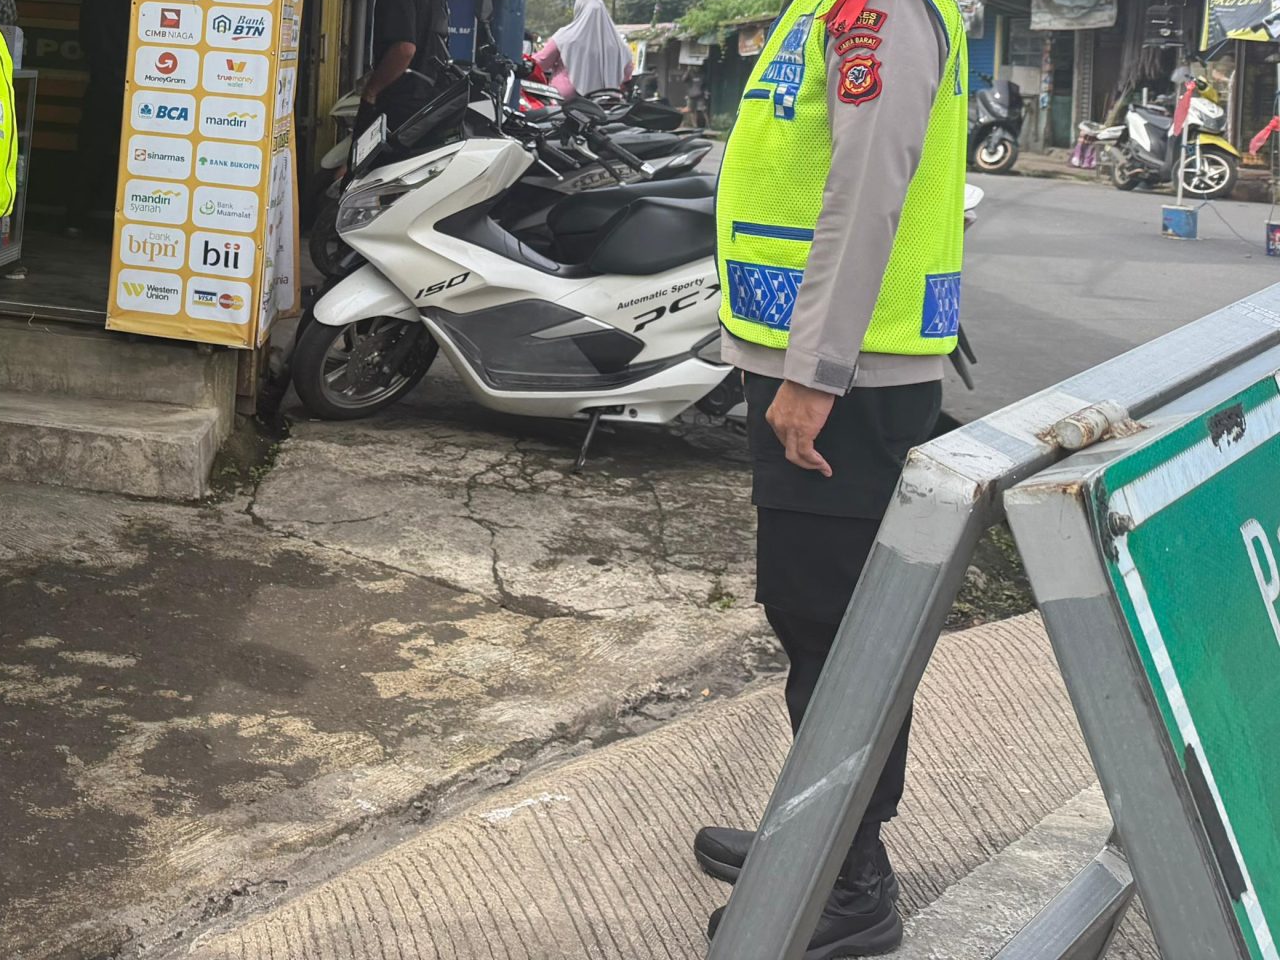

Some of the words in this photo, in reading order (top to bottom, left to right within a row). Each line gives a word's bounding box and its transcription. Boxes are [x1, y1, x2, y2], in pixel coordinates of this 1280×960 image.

[238, 15, 265, 26] Bank
[145, 29, 167, 38] CIMB
[167, 30, 193, 40] NIAGA
[233, 25, 265, 37] BTN
[840, 40, 855, 51] JAWA
[855, 37, 877, 47] BARAT
[145, 74, 186, 85] MoneyGram
[217, 74, 253, 83] truemoney
[156, 105, 189, 121] BCA
[206, 116, 247, 128] mandiri
[147, 152, 185, 162] sinarmas
[209, 159, 228, 167] BANK
[230, 161, 260, 170] BUKOPIN
[131, 193, 171, 205] mandiri
[217, 209, 251, 219] Muamalat
[149, 232, 171, 241] bank
[128, 234, 177, 262] btpn
[202, 240, 241, 269] bii
[147, 284, 179, 295] Western
[414, 271, 471, 300] 150
[146, 291, 170, 301] Union
[616, 286, 669, 311] Automatic
[670, 276, 705, 299] Sporty
